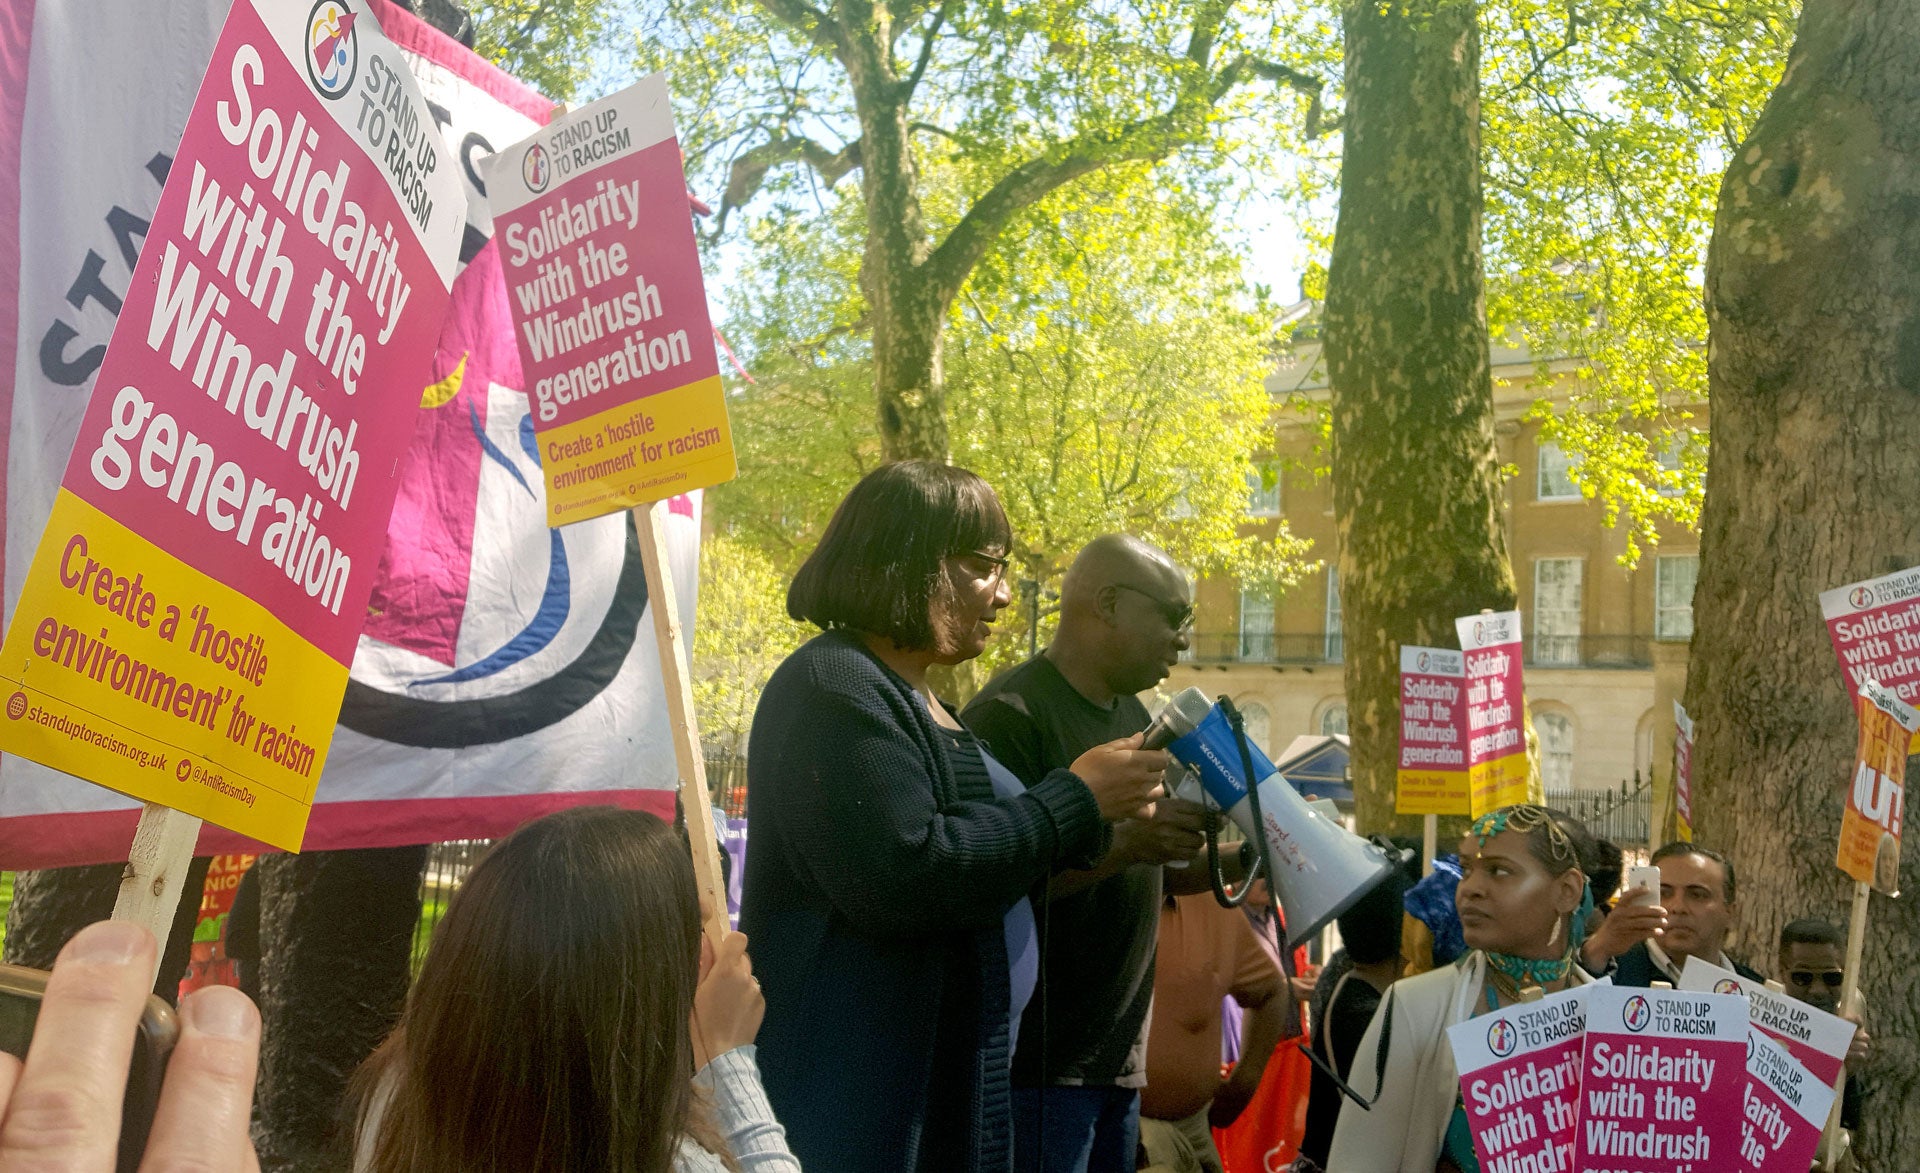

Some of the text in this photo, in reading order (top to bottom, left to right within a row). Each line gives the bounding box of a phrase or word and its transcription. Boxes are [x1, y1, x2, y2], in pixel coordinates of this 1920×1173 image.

[365, 54, 436, 179] STAND UP
[550, 108, 617, 155] STAND UP
[357, 90, 433, 233] TO RACISM
[554, 127, 631, 178] TO RACISM
[216, 44, 411, 345] Solidarity
[505, 179, 639, 268] Solidarity
[40, 151, 173, 386] STA
[182, 160, 365, 396] with the
[515, 240, 629, 315] with the
[522, 274, 663, 363] Windrush
[146, 240, 360, 512] Windrush
[535, 329, 692, 422] generation
[548, 434, 593, 463] Create
[595, 434, 604, 448] a
[641, 442, 662, 464] for
[668, 427, 721, 457] racism
[90, 386, 352, 617] generation
[60, 534, 156, 629] Create
[159, 605, 181, 642] a
[1874, 577, 1906, 592] STAND
[1878, 592, 1892, 603] TO
[1466, 650, 1510, 680] Solidarity
[1843, 637, 1892, 664] with
[1404, 677, 1459, 705] Solidarity
[1404, 700, 1451, 721] with the
[1467, 676, 1504, 705] with the
[225, 694, 255, 747] for
[253, 724, 316, 778] racism
[1403, 721, 1457, 743] Windrush
[1469, 699, 1511, 732] Windrush
[28, 705, 257, 808] standuptoracism.org.uk @AntiRacismDay
[1402, 744, 1463, 767] generation
[1470, 724, 1518, 763] generation
[1200, 743, 1241, 790] MONACOR
[1518, 999, 1579, 1031] STAND UP
[1656, 1000, 1711, 1018] STAND UP
[1656, 1017, 1716, 1035] TO RACISM
[1761, 1010, 1812, 1041] RACISM
[1790, 1008, 1809, 1023] UP
[1522, 1030, 1541, 1047] TO
[1591, 1042, 1716, 1093] Solidarity
[1756, 1058, 1802, 1108] TO RACISM
[1758, 1043, 1803, 1086] STAND UP
[1589, 1082, 1697, 1122] with the
[1480, 1106, 1537, 1156] with
[1586, 1120, 1711, 1161] Windrush
[1741, 1121, 1766, 1169] he
